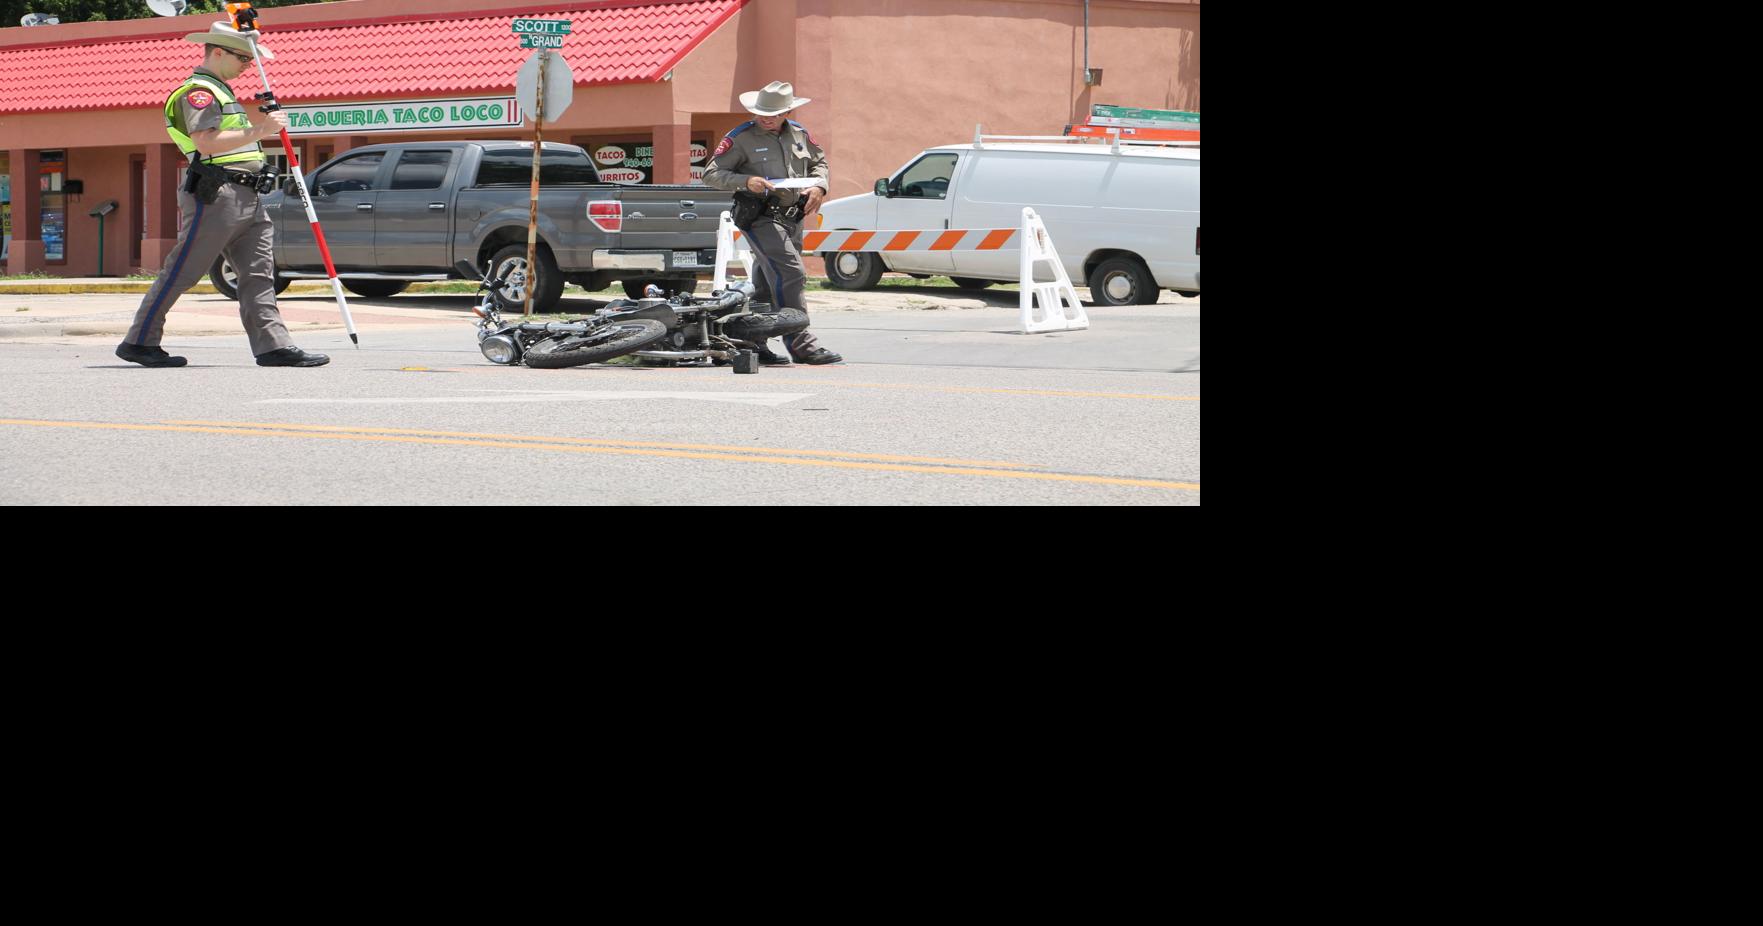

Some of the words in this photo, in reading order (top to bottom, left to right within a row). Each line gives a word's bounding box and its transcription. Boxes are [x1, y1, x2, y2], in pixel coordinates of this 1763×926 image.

[515, 20, 559, 32] SCOTT
[531, 35, 563, 47] GRAND
[288, 108, 389, 128] TAQUERIA
[392, 107, 445, 124] TACO
[450, 103, 504, 122] LOCO
[597, 150, 625, 159] TACOS
[600, 172, 640, 182] URRITOS
